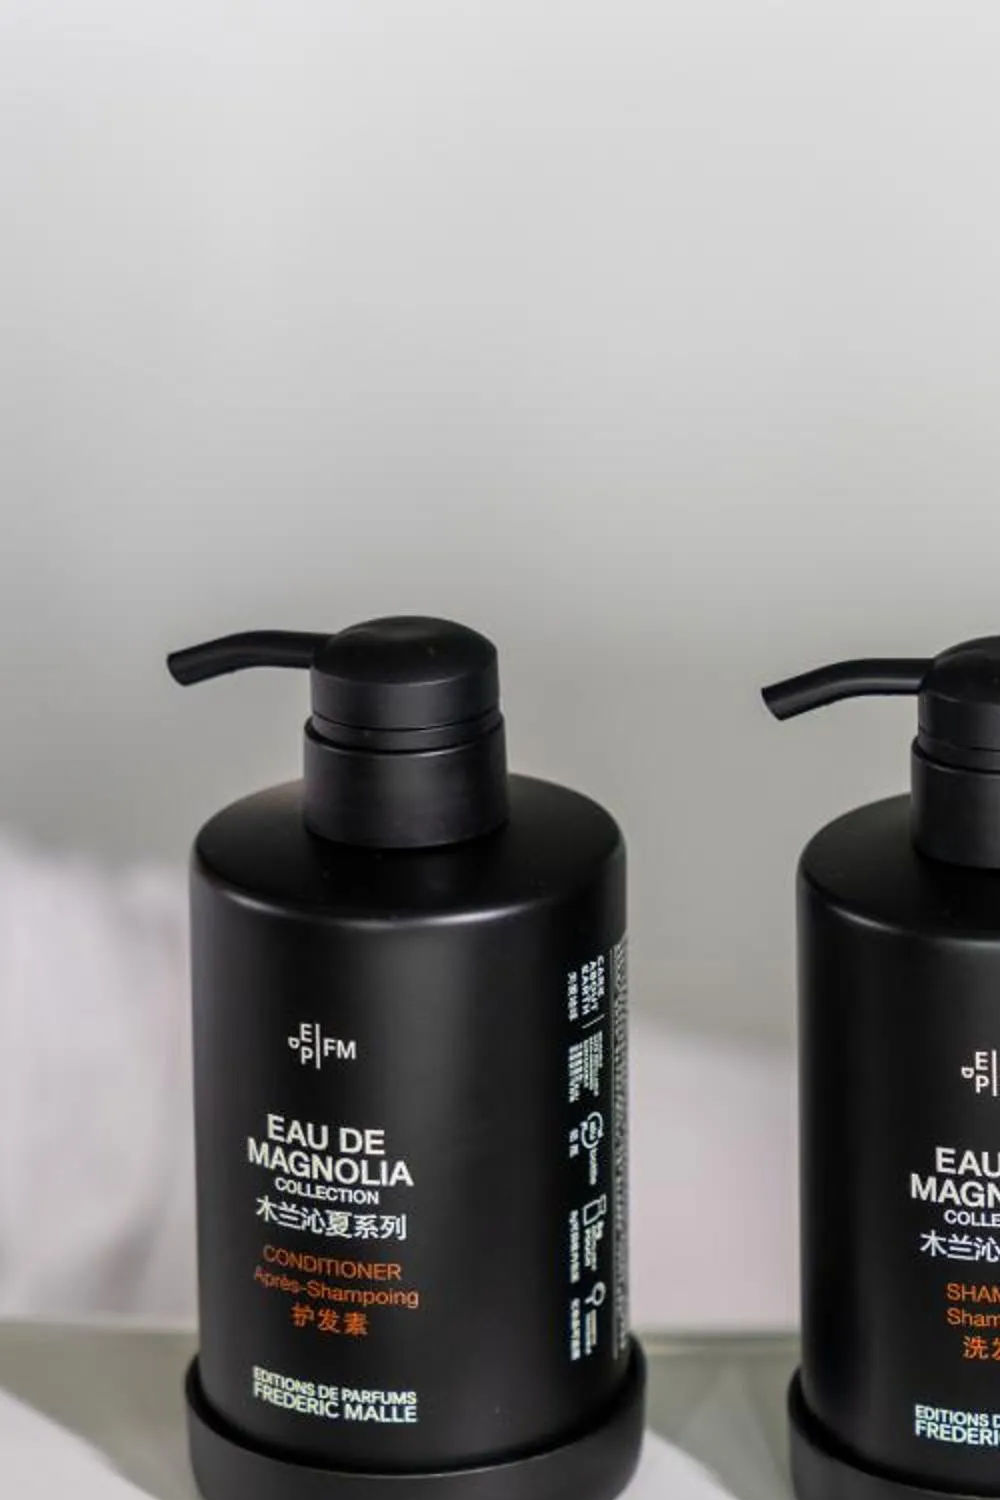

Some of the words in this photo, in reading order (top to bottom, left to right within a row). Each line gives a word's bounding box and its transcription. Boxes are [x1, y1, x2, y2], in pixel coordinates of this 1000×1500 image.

[266, 1113, 329, 1150] EAU
[338, 1127, 386, 1156] DE
[247, 1137, 415, 1187] MAGNOLIA
[274, 1177, 380, 1205] COLLECTION
[255, 1195, 407, 1241] 木兰沁夏系列
[262, 1244, 402, 1281] CONDITIONER
[290, 1302, 368, 1337] 护发素
[252, 1365, 316, 1397] EDITIONS
[317, 1384, 340, 1401] DE
[341, 1387, 418, 1406] PARFUMS
[252, 1380, 341, 1419] FREDERIC
[343, 1403, 418, 1424] MALLE
[914, 1404, 990, 1428] EDITIONS
